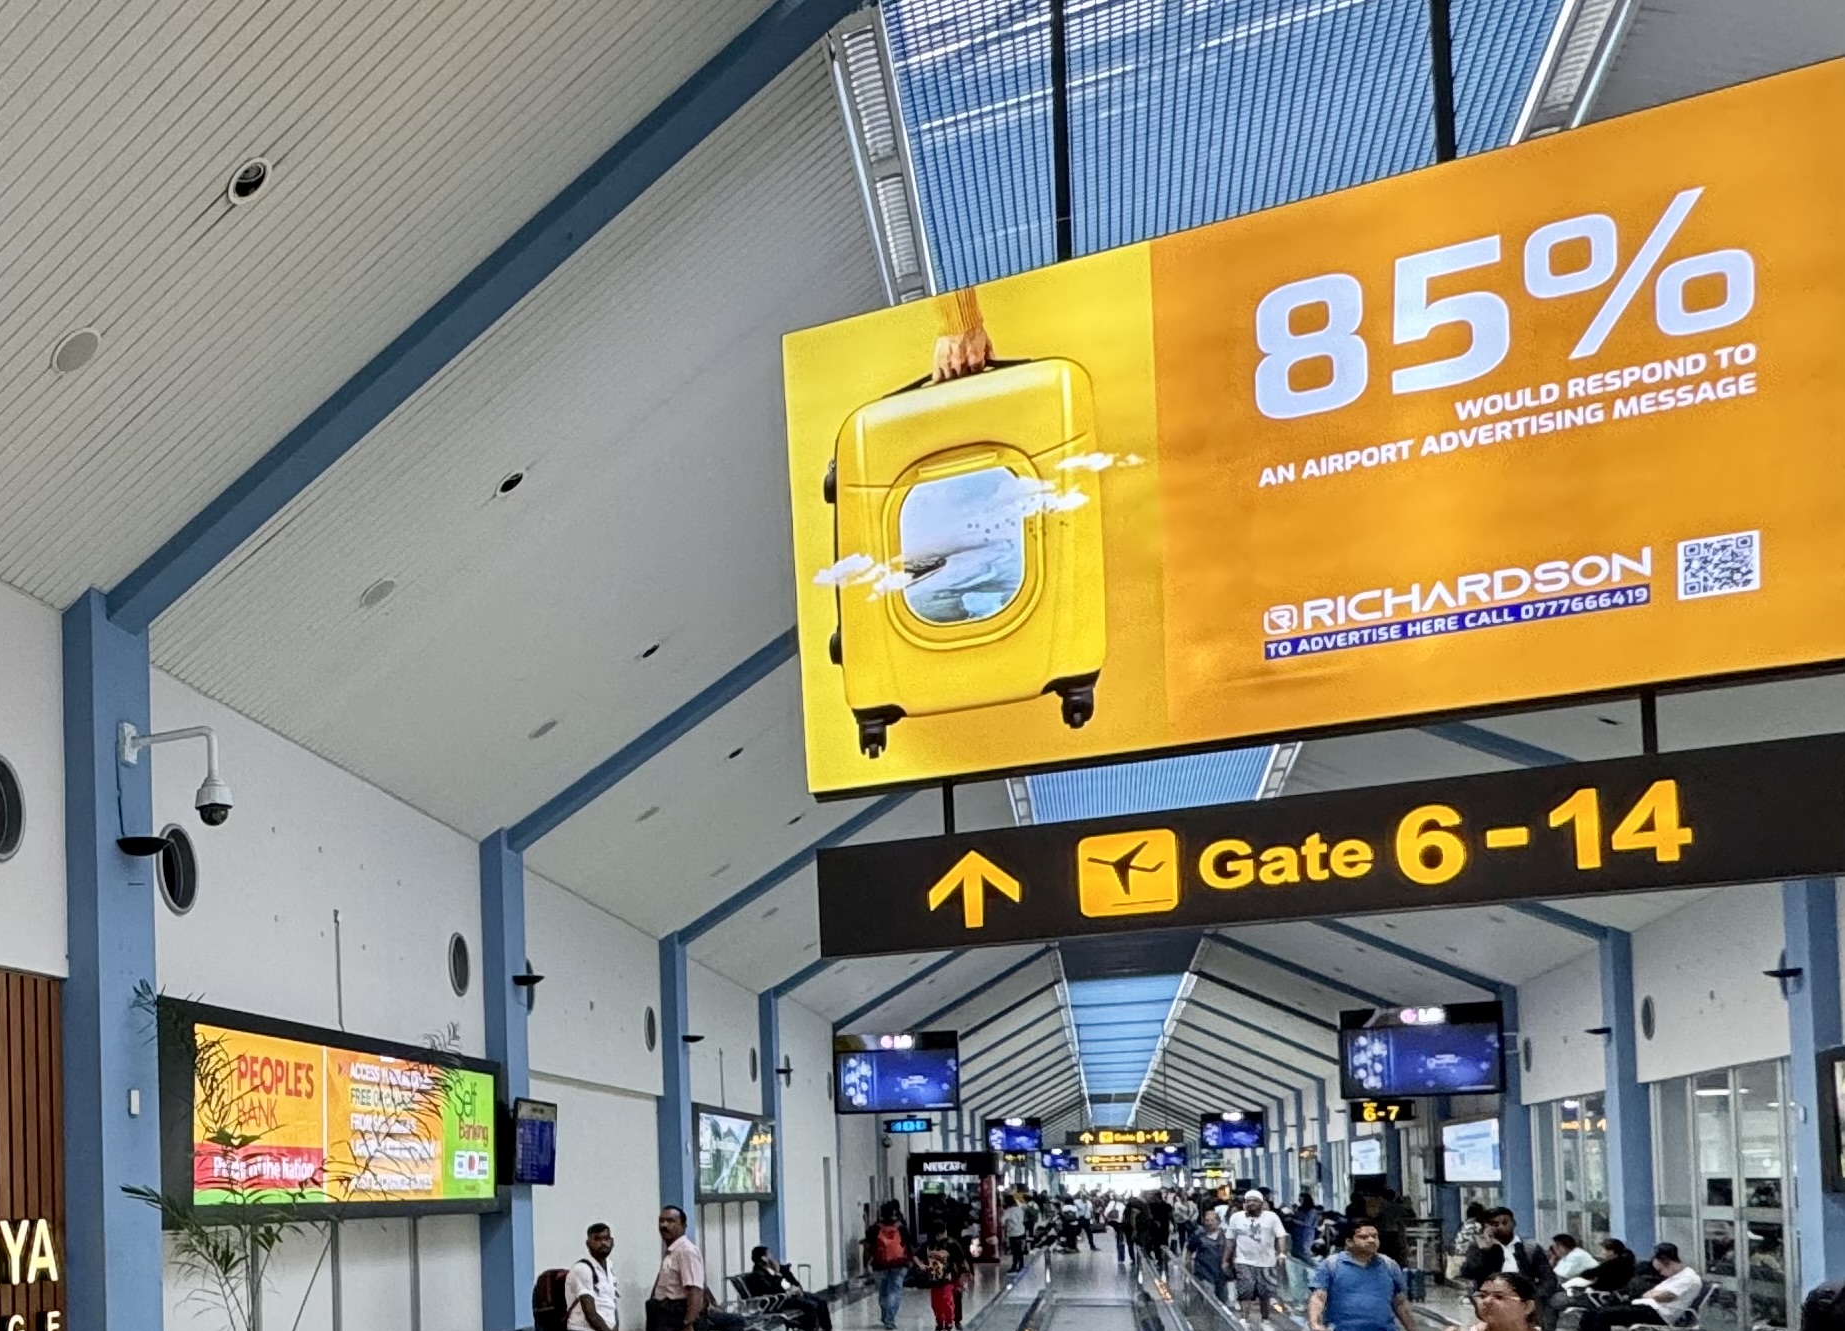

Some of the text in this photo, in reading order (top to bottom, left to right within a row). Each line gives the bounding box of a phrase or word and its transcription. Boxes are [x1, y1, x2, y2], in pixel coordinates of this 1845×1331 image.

[1255, 186, 1755, 420] 85%
[1455, 342, 1757, 421] WOULD RESPOND TO
[1258, 373, 1757, 487] AN AIRPORT ADVERTISING MESSAGE
[1266, 586, 1649, 658] TO ADVERTISE HERE CALL 0777666419
[1301, 546, 1653, 631] RICHARDSON
[1198, 829, 1374, 890] Gate
